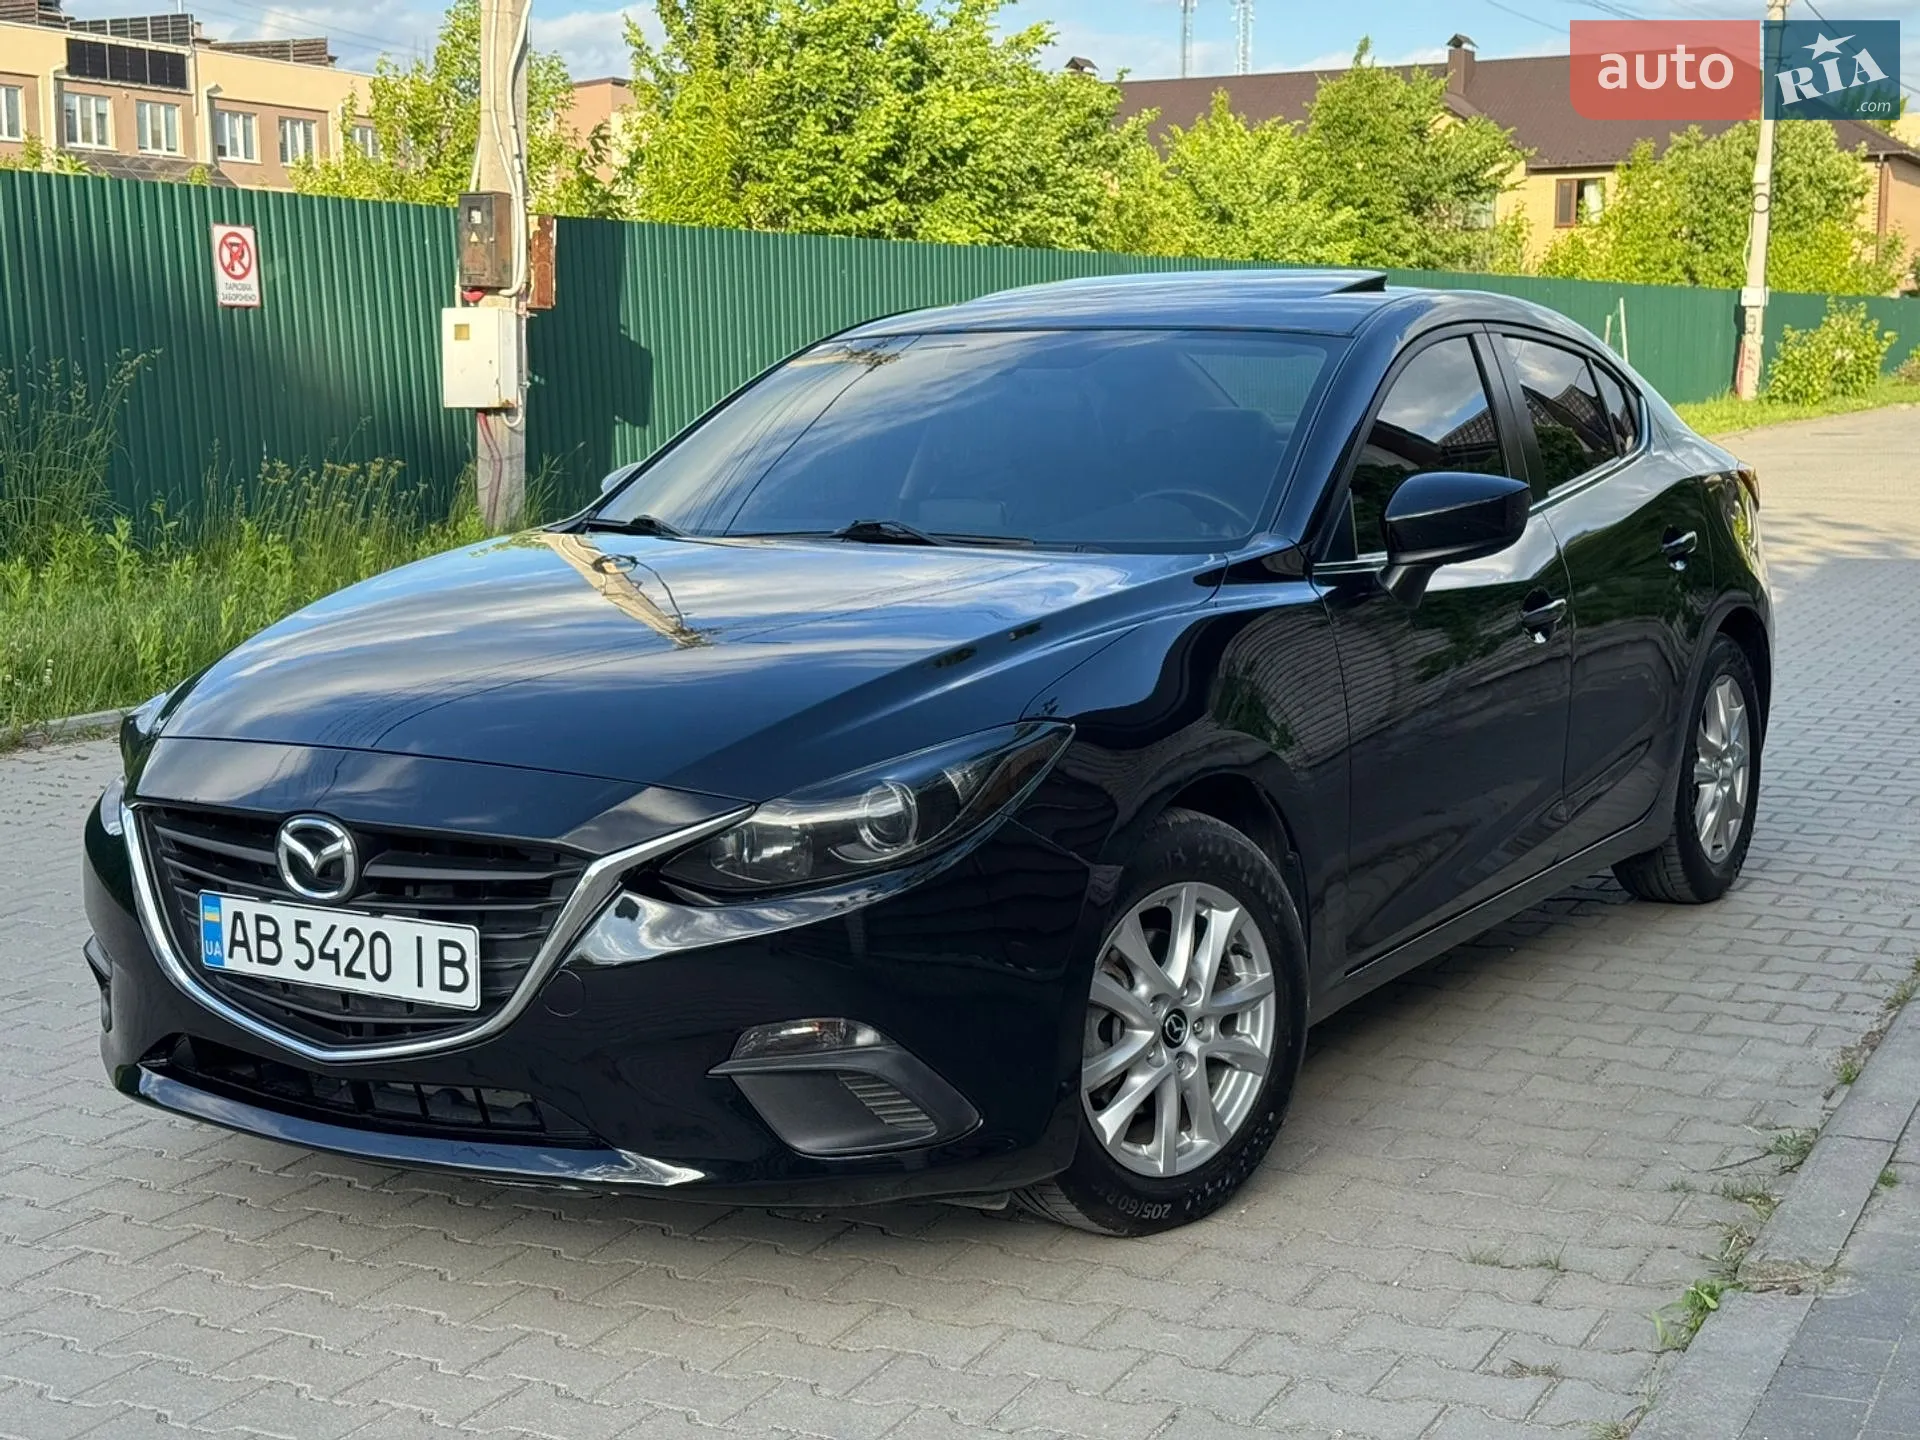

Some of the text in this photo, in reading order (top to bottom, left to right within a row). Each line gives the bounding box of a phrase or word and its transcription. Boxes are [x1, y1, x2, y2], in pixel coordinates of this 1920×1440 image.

[205, 940, 222, 957] UA
[228, 911, 469, 993] AB 5420 IB
[1118, 1195, 1172, 1219] 205/60
